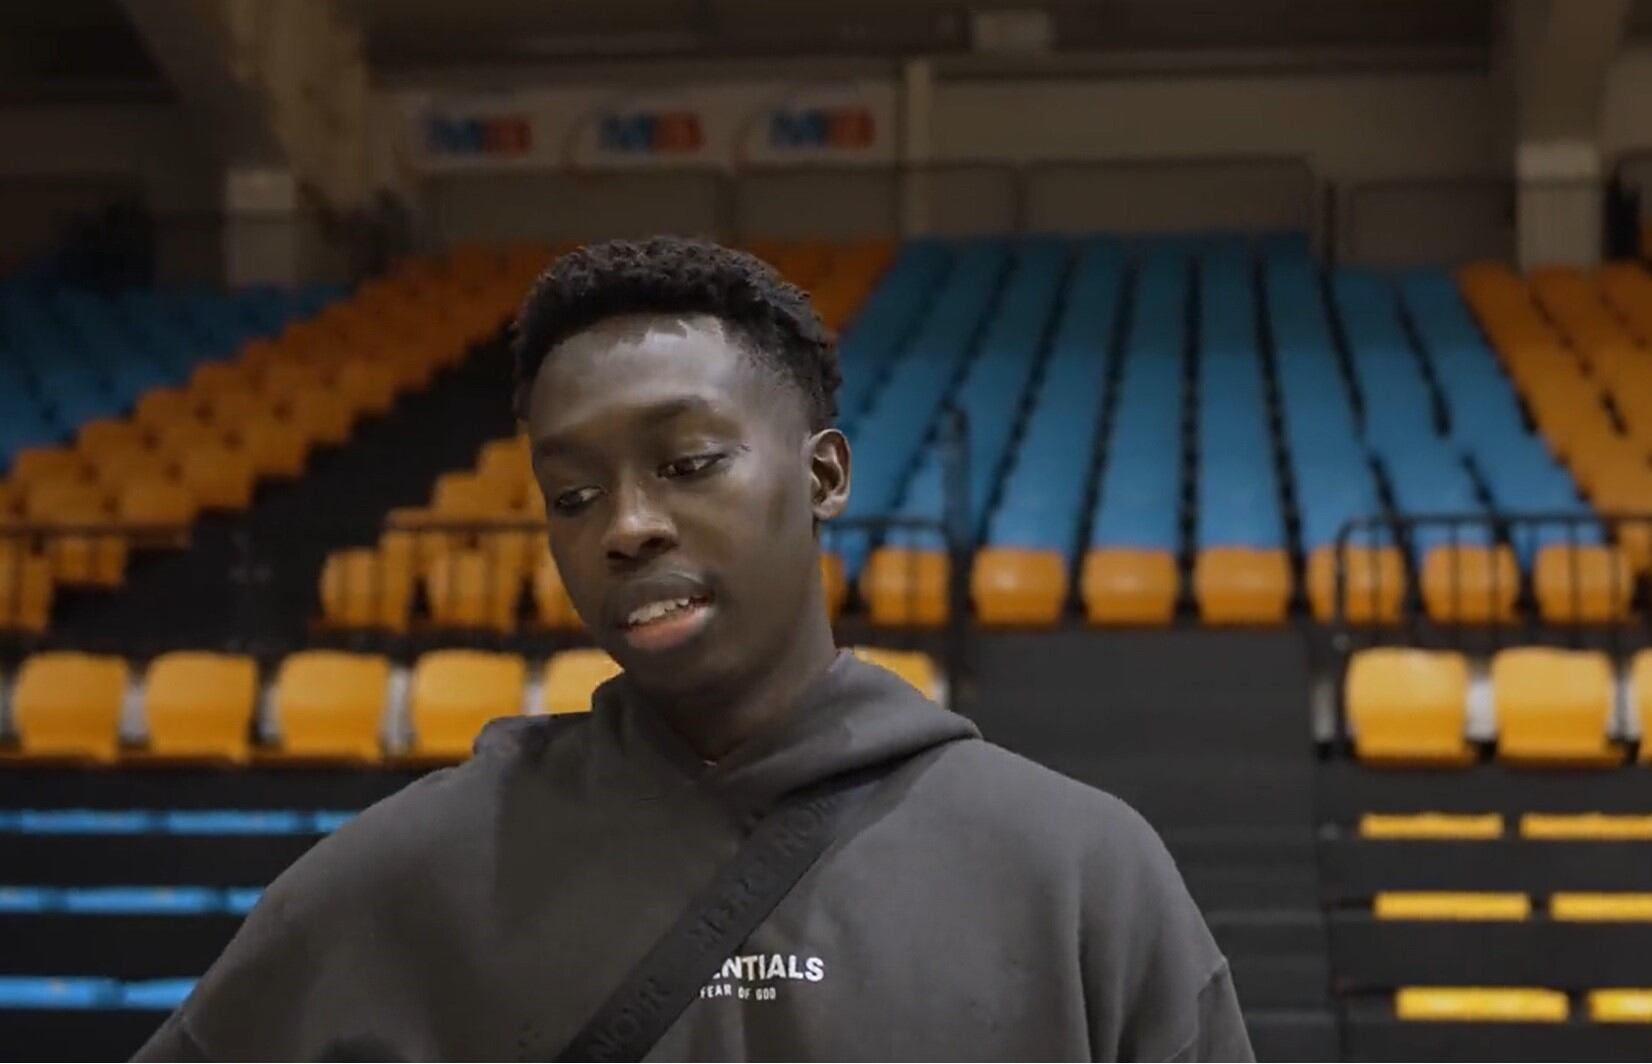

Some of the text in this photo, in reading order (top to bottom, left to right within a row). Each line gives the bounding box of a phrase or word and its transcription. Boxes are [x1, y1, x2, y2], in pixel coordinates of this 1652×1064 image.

[712, 953, 824, 982] NTIALS
[700, 984, 776, 1000] FEAR OF GOD
